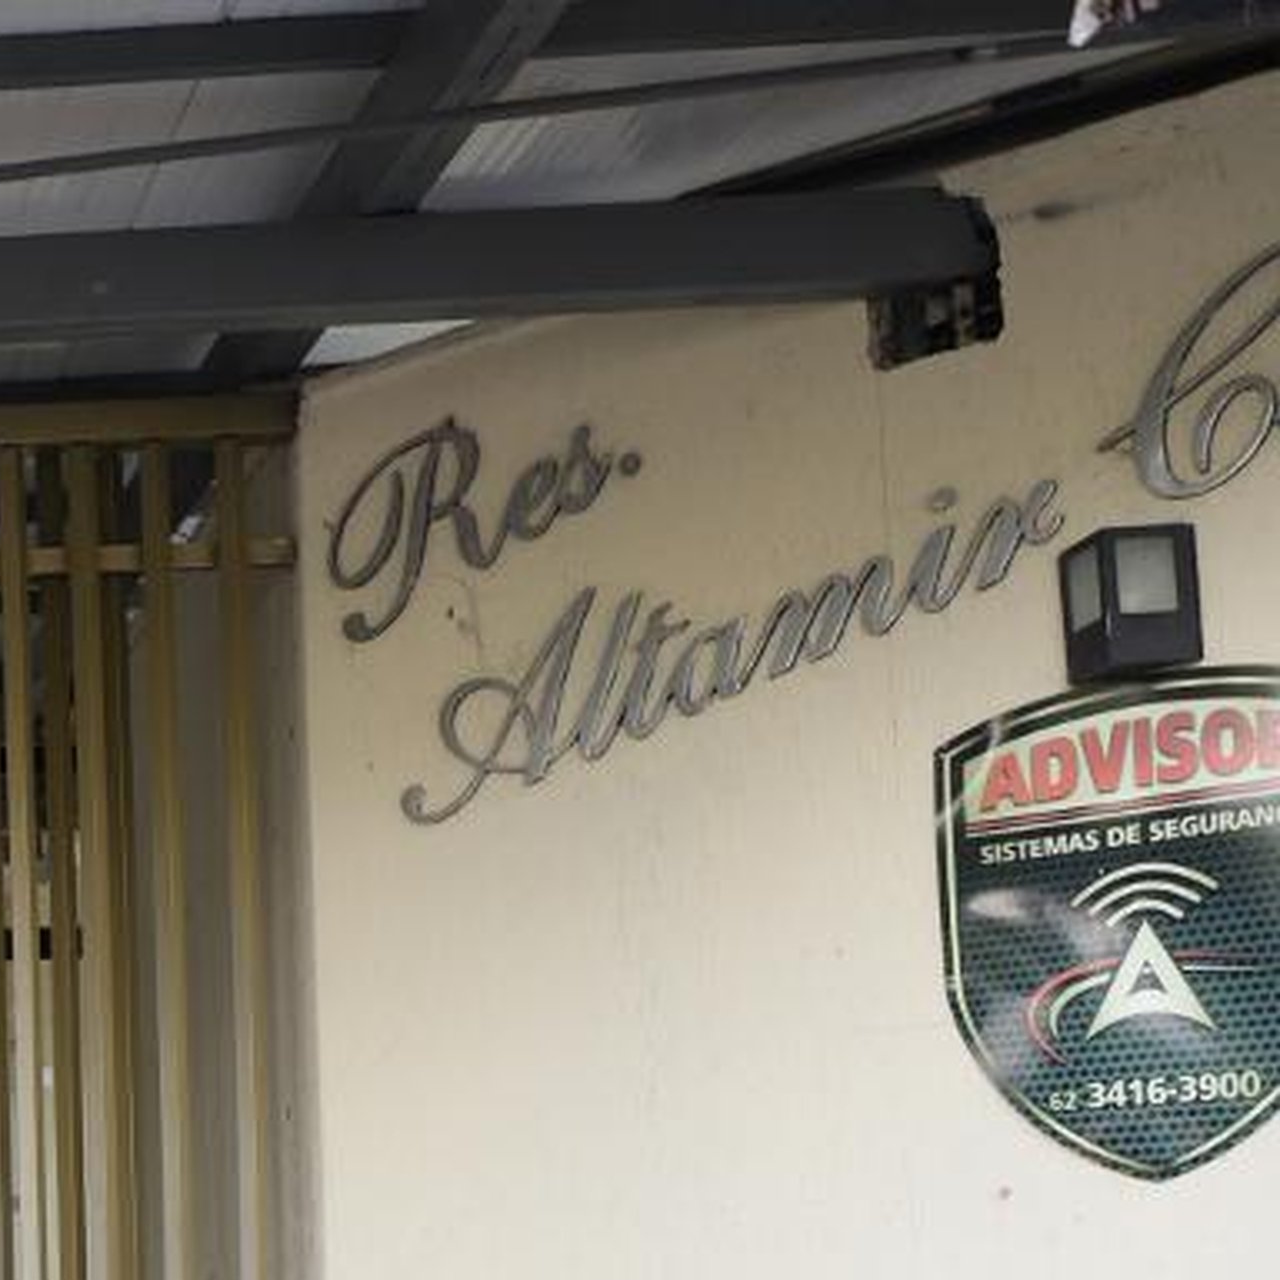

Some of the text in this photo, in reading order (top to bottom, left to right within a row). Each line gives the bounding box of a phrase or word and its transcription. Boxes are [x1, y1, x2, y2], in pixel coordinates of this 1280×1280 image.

[325, 414, 642, 644] Res.
[980, 803, 1280, 865] SISTEMAS DE SEGURAN
[1087, 1070, 1261, 1109] 3416-3900
